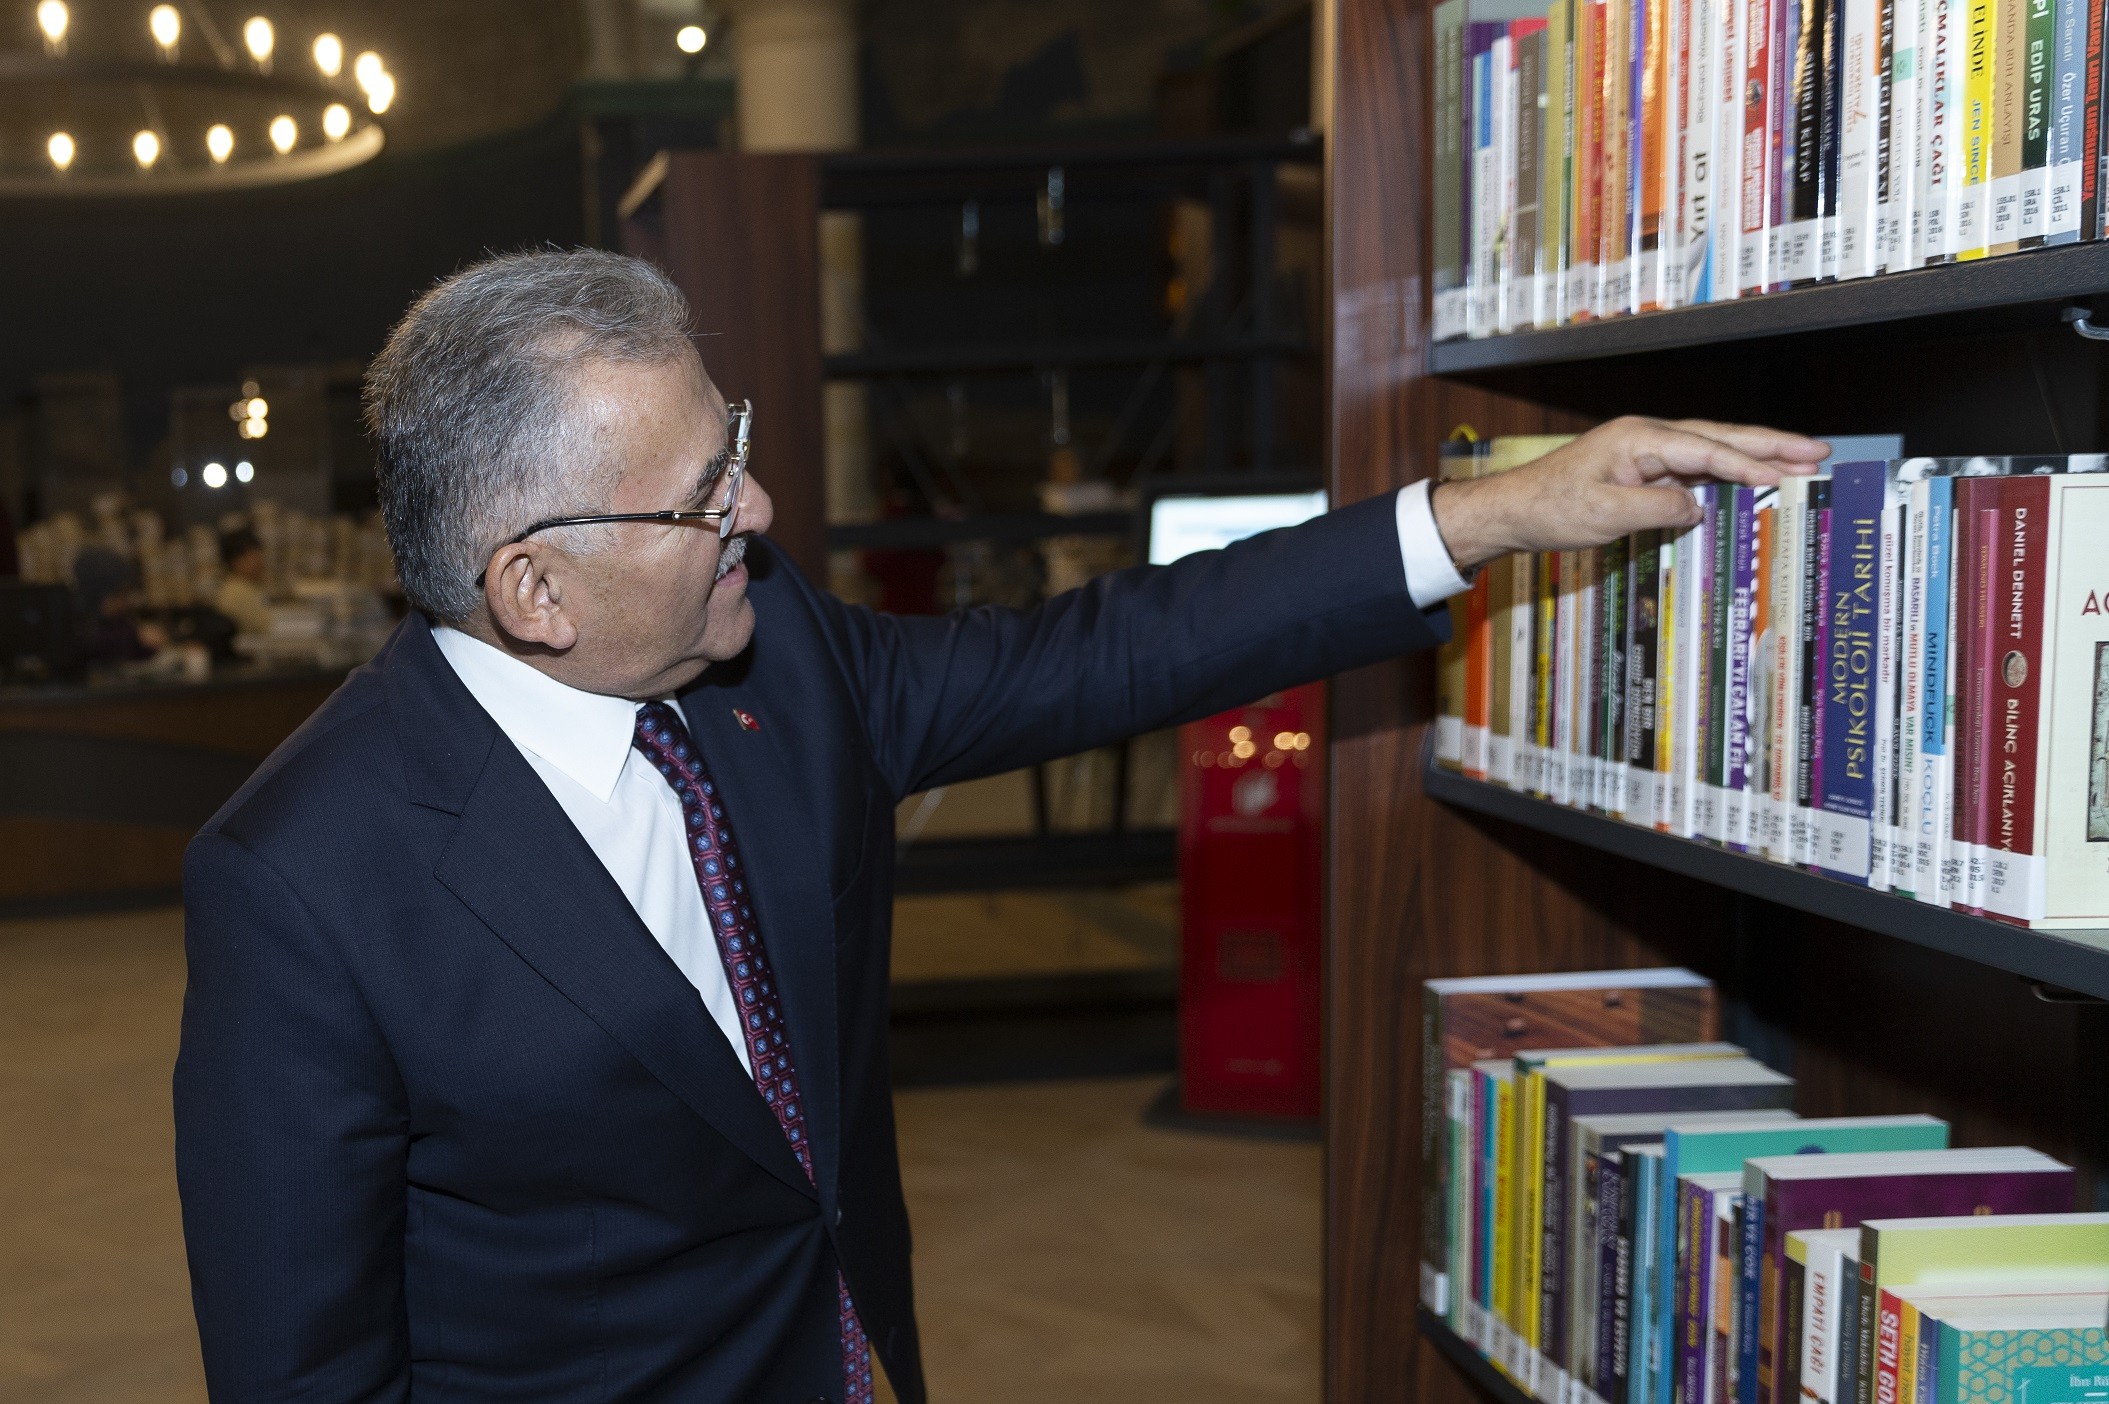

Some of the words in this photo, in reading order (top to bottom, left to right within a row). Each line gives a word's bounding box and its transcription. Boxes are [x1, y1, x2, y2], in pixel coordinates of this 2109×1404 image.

[1881, 3, 1892, 48] TEK
[1970, 5, 1988, 80] ELİNDE
[2063, 18, 2076, 62] Sanatı
[2004, 49, 2014, 77] RUH
[2030, 39, 2045, 84] EDİP
[2061, 72, 2077, 101] Özer
[1971, 98, 1982, 131] JEN
[2001, 83, 2013, 146] ANLAYIŞI
[2027, 89, 2042, 141] URAS
[2058, 105, 2074, 153] Uçuran
[1692, 152, 1708, 182] at
[1799, 127, 1813, 183] KİTAP
[1930, 135, 1944, 187] ÇAĞI
[1690, 193, 1705, 244] Yırt
[1931, 504, 1941, 542] Petra
[2013, 507, 2028, 566] DANIEL
[1851, 517, 1876, 620] TARİHİ
[1884, 533, 1894, 562] güzel
[1930, 544, 1940, 578] Bock
[1980, 545, 1989, 588] EDMUND
[1883, 565, 1893, 615] konuşma
[1978, 590, 1987, 630] HUSSERL
[2010, 570, 2025, 639] DENNETT
[1831, 591, 1850, 704] MODERN
[1883, 618, 1891, 632] bir
[1881, 635, 1891, 683] markadır
[1908, 633, 1919, 668] MUTLU
[1845, 630, 1873, 779] PSİKOLOJİ
[1906, 672, 1917, 712] OLMAYA
[1925, 632, 1938, 743] MINDFUCK
[1905, 716, 1915, 735] VAR
[2003, 698, 2021, 753] BİLİNÇ
[1812, 1272, 1827, 1332] EMPATİ
[1809, 1334, 1824, 1375] ÇAĞI
[1879, 1310, 1899, 1367] SETH
